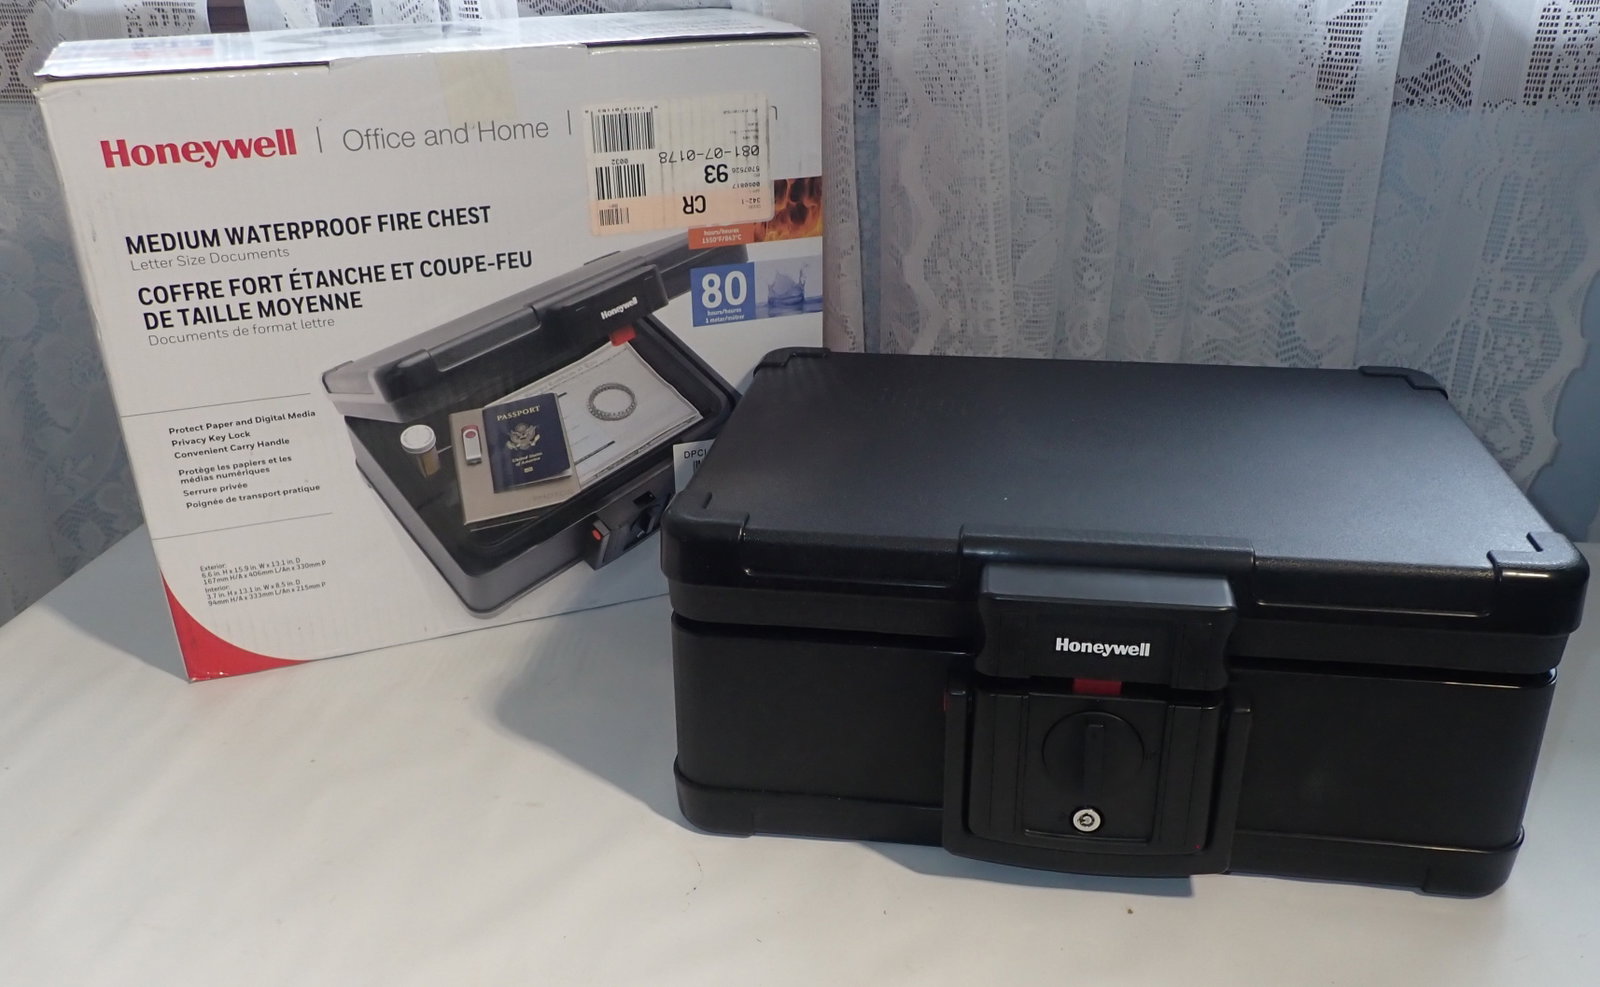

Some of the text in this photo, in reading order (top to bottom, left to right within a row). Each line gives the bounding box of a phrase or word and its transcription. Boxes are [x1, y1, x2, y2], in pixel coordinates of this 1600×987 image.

[100, 120, 549, 169] Honeywell Office and Home
[658, 144, 760, 164] 081-07-0178
[704, 163, 729, 184] 93
[682, 195, 706, 215] CR
[125, 206, 491, 255] MEDIUM WATERPROOF FIRE CHEST
[130, 247, 290, 272] Letter Size Documents
[137, 250, 533, 306] COFFRE FORT ÉTANCHE ET COUPE-FEU
[701, 270, 747, 309] 80
[143, 292, 363, 331] DE TAILLE MOYENNE
[600, 296, 638, 320] Honeywell
[148, 315, 335, 347] Documents de format lettre
[169, 410, 316, 434] Protect Paper and Digital Media
[496, 405, 540, 421] PASSPORT
[171, 430, 251, 447] Privacy Key Lock
[174, 438, 290, 460] Convenient Carry Handle
[683, 448, 707, 459] DPCI
[178, 465, 215, 476] Protège
[217, 463, 231, 471] les
[233, 459, 266, 470] papiers
[180, 466, 270, 485] médias numériques
[183, 482, 248, 497] Serrure privée
[186, 484, 320, 509] Poignée de transport pratique
[203, 576, 229, 585] 167mm
[230, 573, 243, 581] H/A
[249, 568, 274, 577] 406mm
[296, 561, 321, 570] 330mm
[208, 598, 229, 607] 94mm
[230, 595, 243, 603] H/A
[1055, 636, 1151, 657] Honeywell
